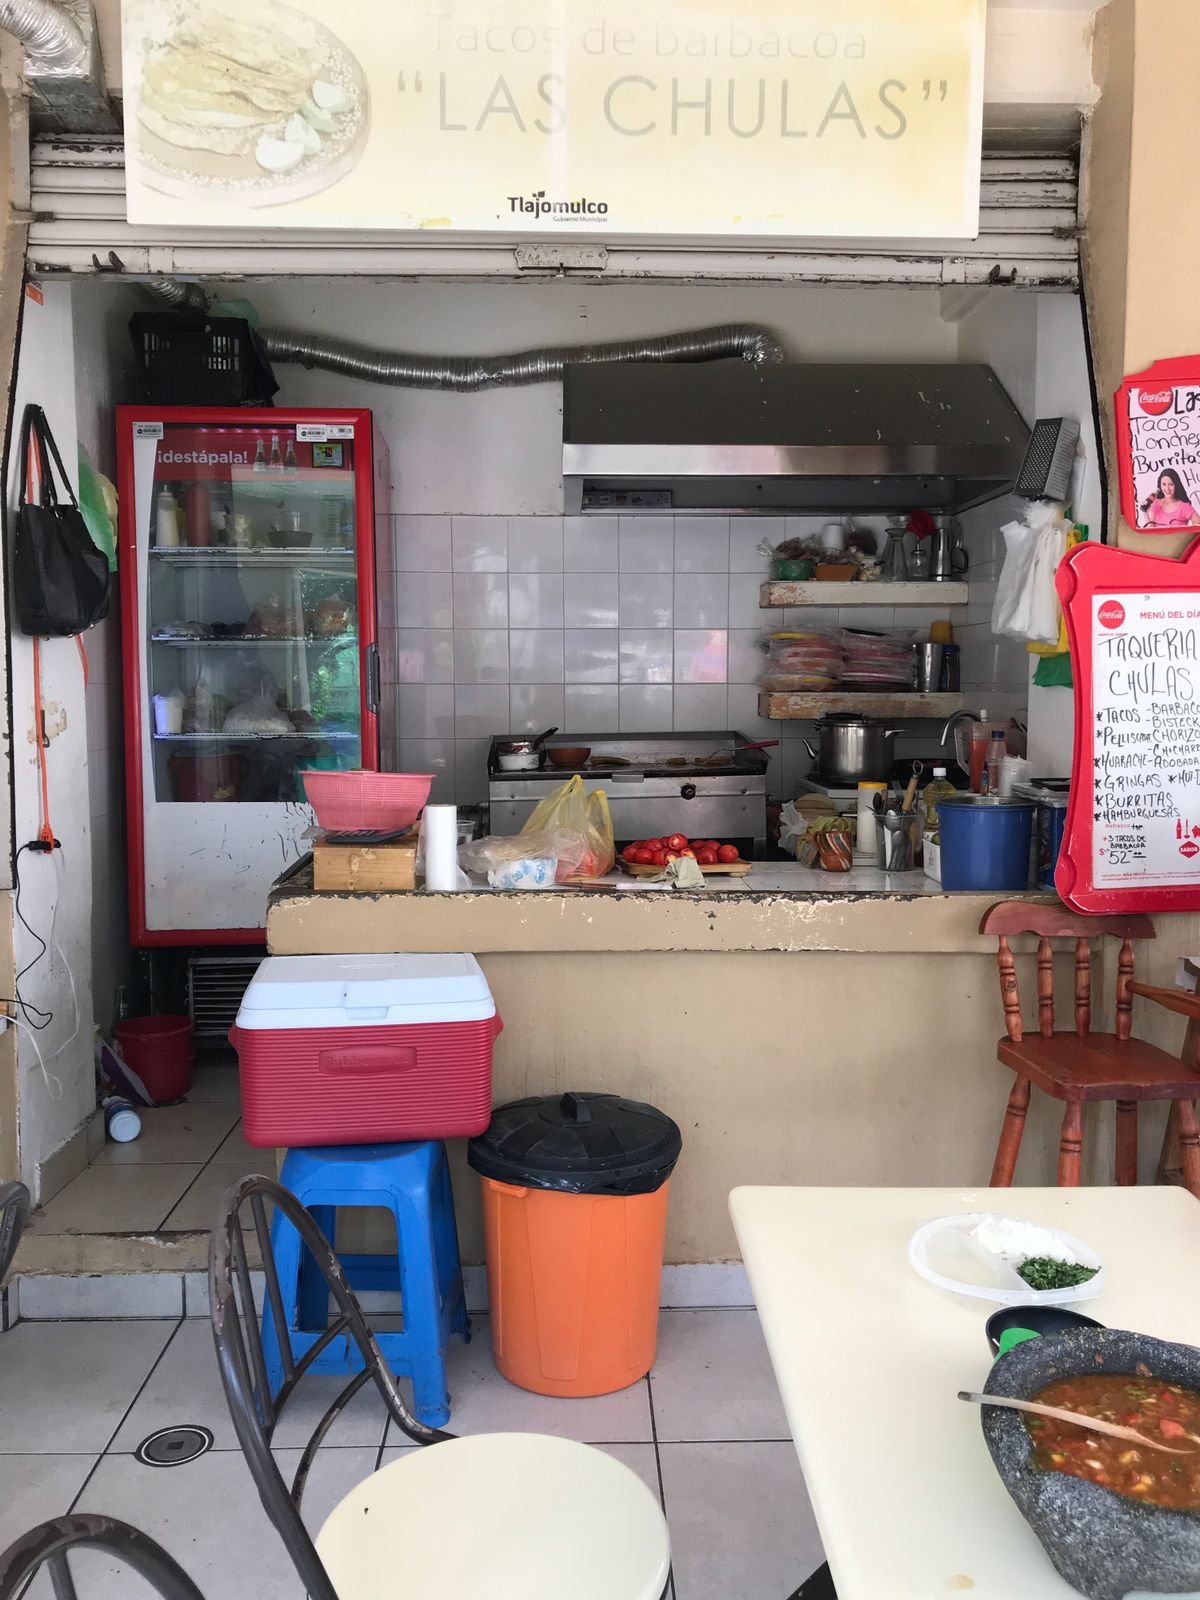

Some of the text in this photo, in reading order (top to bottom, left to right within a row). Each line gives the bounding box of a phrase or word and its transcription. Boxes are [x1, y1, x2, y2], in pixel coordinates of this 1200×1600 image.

[427, 14, 867, 60] Tacos de barbacoa
[507, 193, 608, 219] Tlajomulco
[1139, 391, 1171, 403] Coca-Cola
[1129, 416, 1190, 434] Tacos
[1099, 609, 1123, 620] Coca-Cola
[1140, 609, 1200, 619] MENÚ DEL DÍA
[1097, 627, 1199, 661] TAQUERIA
[1109, 662, 1194, 704] CHULAS
[1104, 773, 1162, 792] GRINGAS
[1105, 791, 1173, 810] BURRITAS
[1136, 835, 1146, 843] DE
